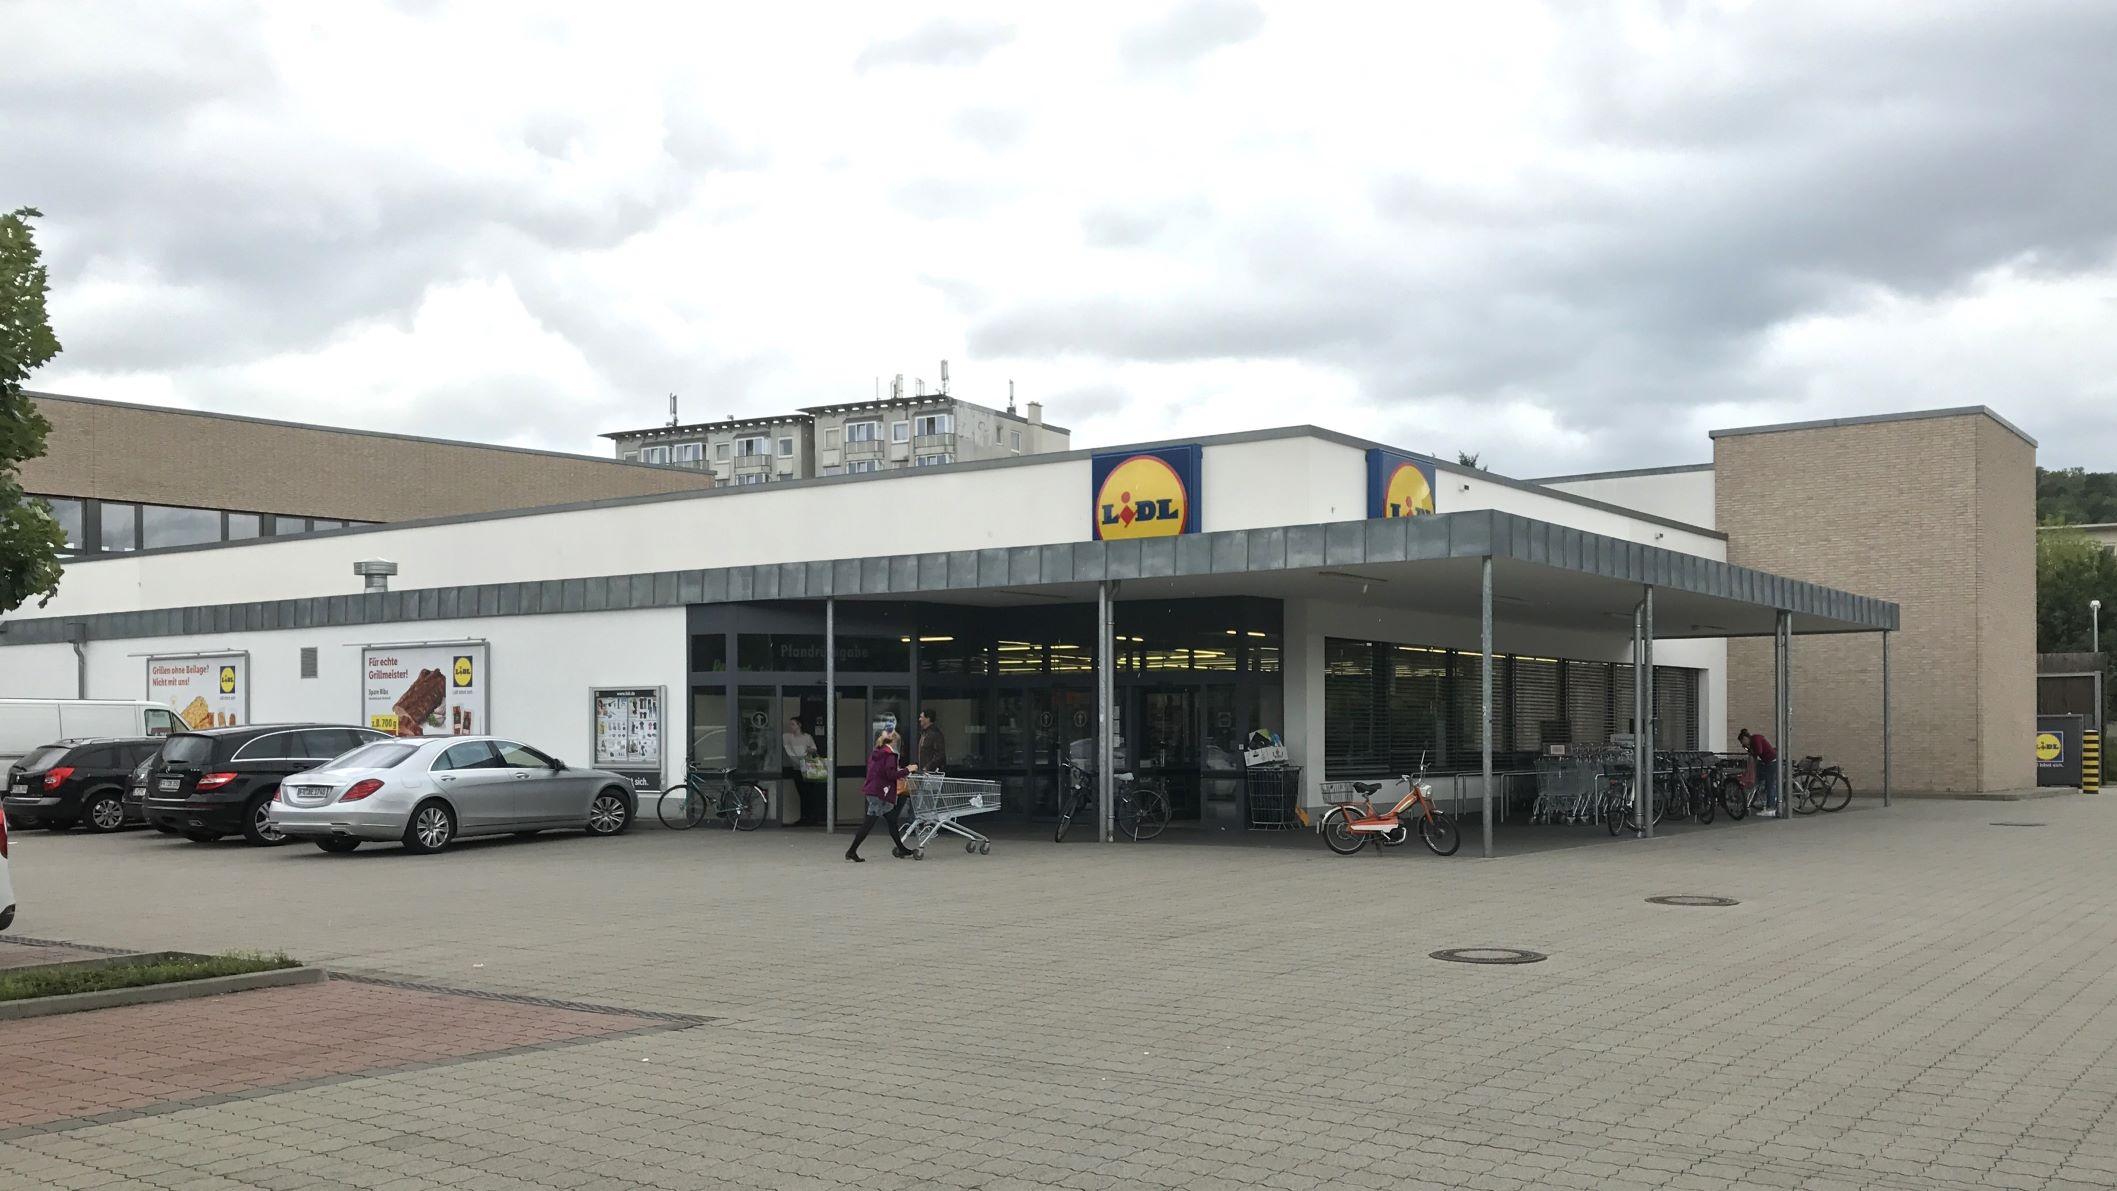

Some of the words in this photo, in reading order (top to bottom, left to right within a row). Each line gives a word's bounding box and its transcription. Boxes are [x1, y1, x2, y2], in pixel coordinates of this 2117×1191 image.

[368, 657, 379, 666] Für
[380, 657, 398, 666] echte
[152, 666, 171, 675] Grillen
[172, 665, 185, 674] ohne
[186, 665, 209, 675] Beilage?
[368, 669, 408, 680] Grillmeister!
[152, 678, 167, 686] Nicht
[168, 677, 177, 686] mit
[178, 677, 190, 686] uns!
[634, 776, 649, 786] sich.
